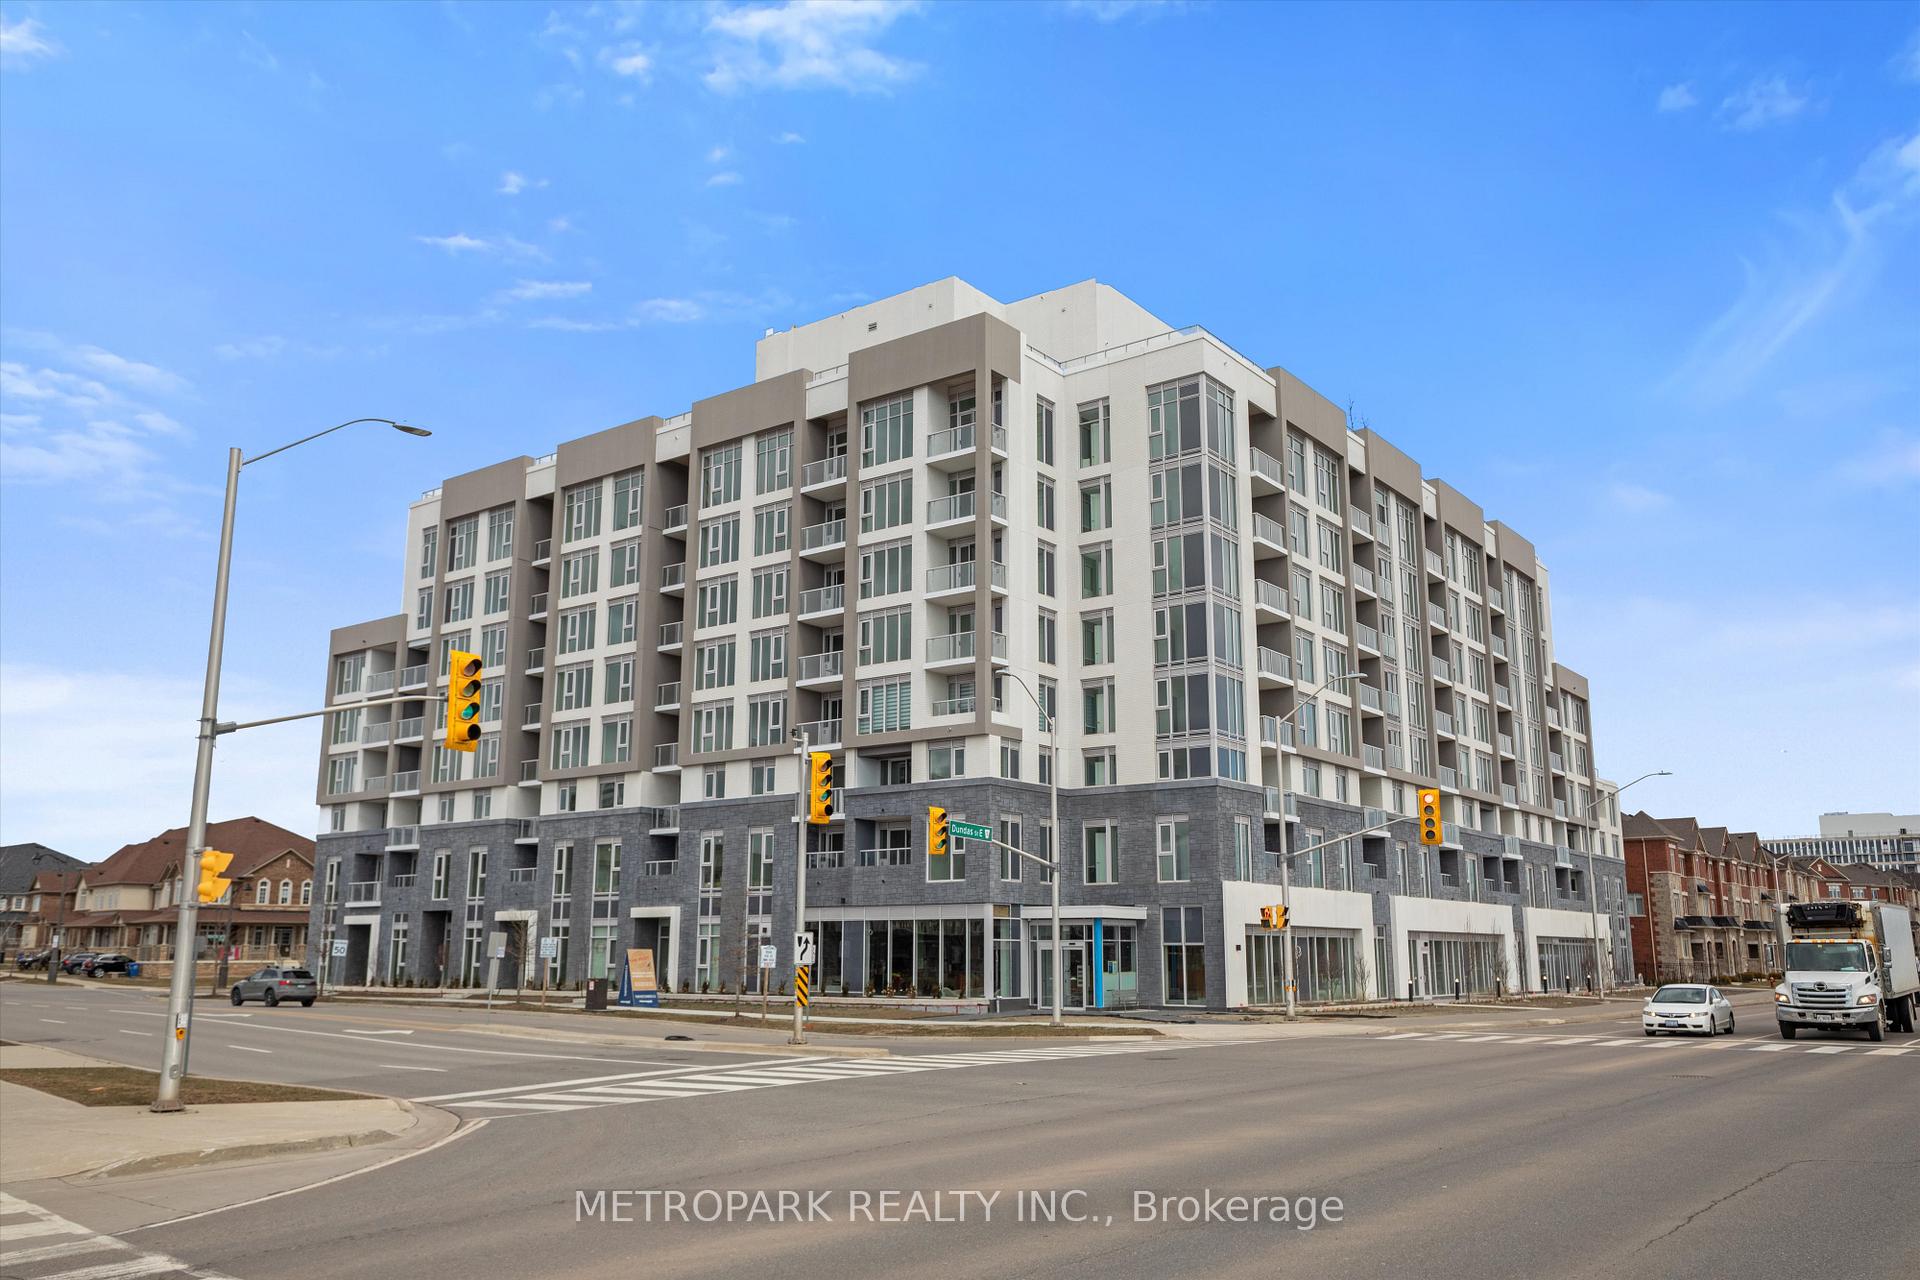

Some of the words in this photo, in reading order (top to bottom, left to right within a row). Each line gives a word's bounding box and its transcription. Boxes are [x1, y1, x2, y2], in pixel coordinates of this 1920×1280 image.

[951, 823, 973, 836] Dundas
[980, 829, 984, 838] E
[334, 946, 346, 955] 50
